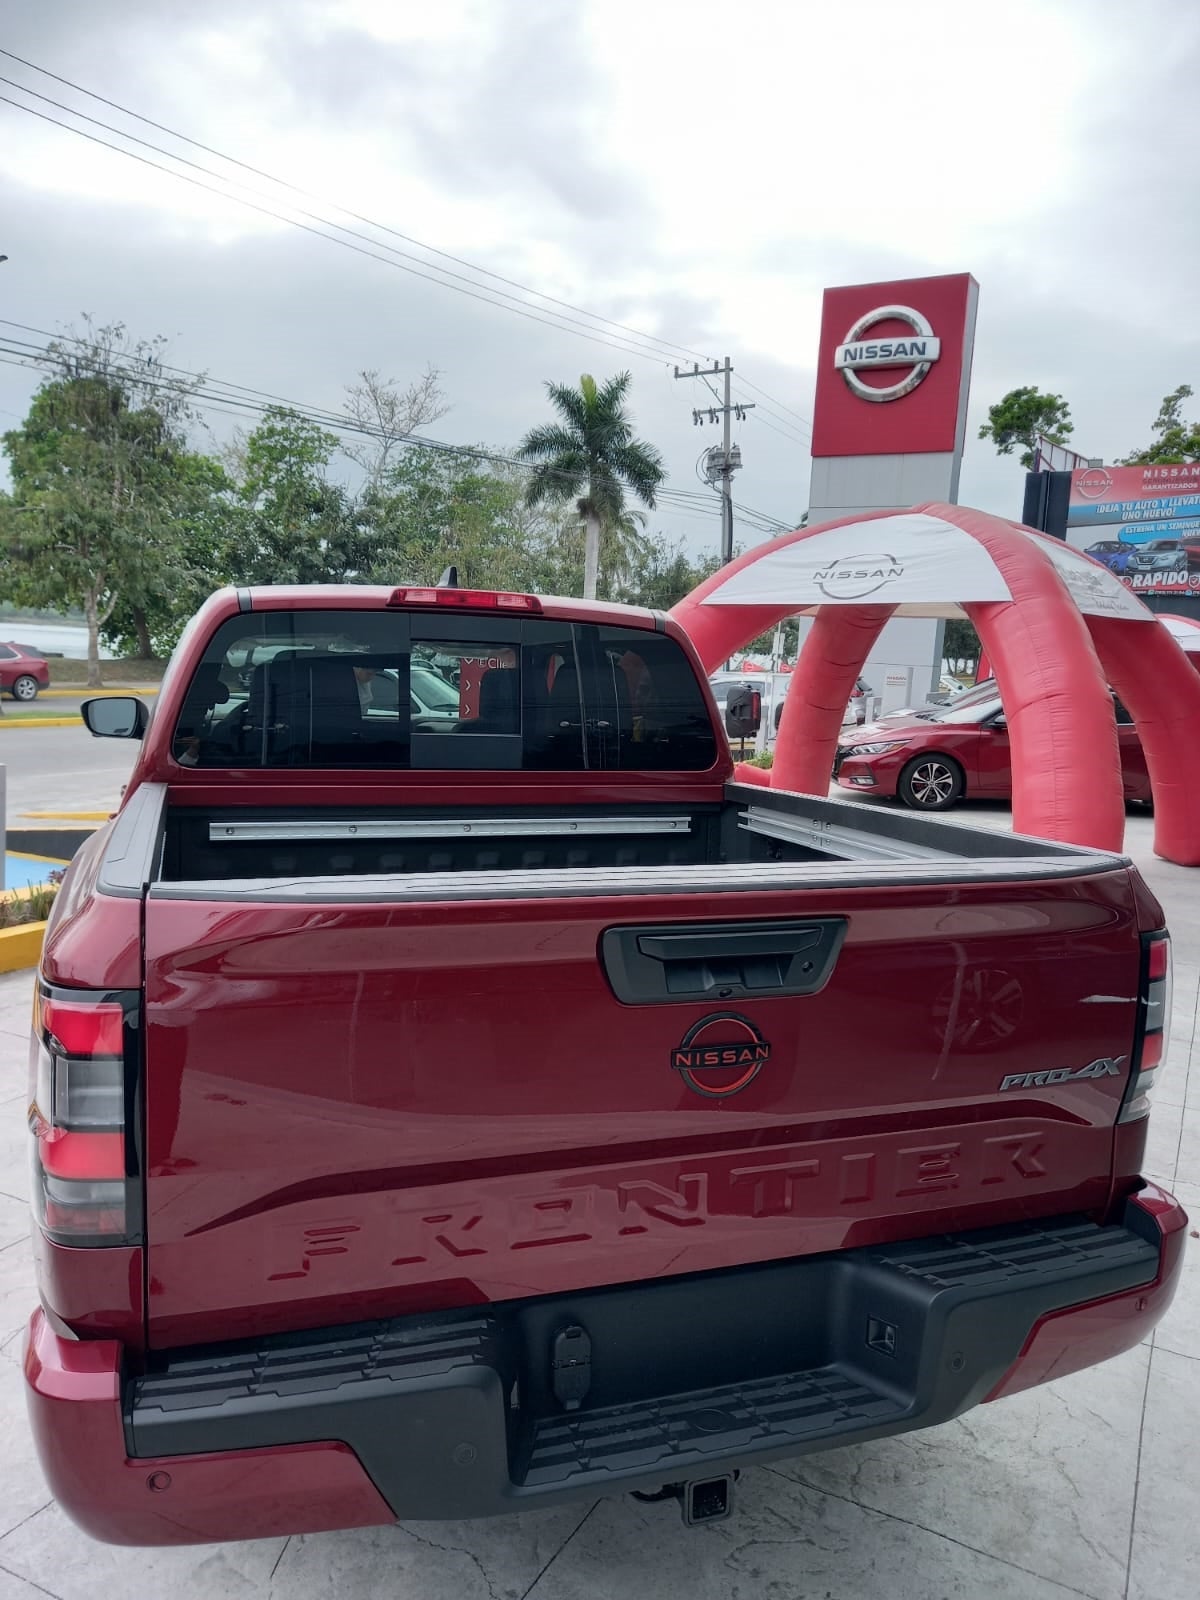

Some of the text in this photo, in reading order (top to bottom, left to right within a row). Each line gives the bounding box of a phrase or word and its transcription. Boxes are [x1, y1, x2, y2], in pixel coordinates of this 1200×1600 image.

[844, 342, 927, 362] NISSAN
[1143, 467, 1200, 478] NISSAN
[1121, 502, 1133, 511] TU
[1134, 500, 1157, 510] AUTO
[1161, 499, 1167, 508] Y
[1122, 508, 1176, 520] UNO NUEVO!
[1125, 524, 1155, 534] ESTRENA
[1157, 523, 1166, 531] UN
[813, 567, 904, 580] NISSAN
[676, 1046, 769, 1066] NISSAN
[1000, 1055, 1128, 1091] PRO-4X
[267, 1130, 1047, 1281] FRONTIER
